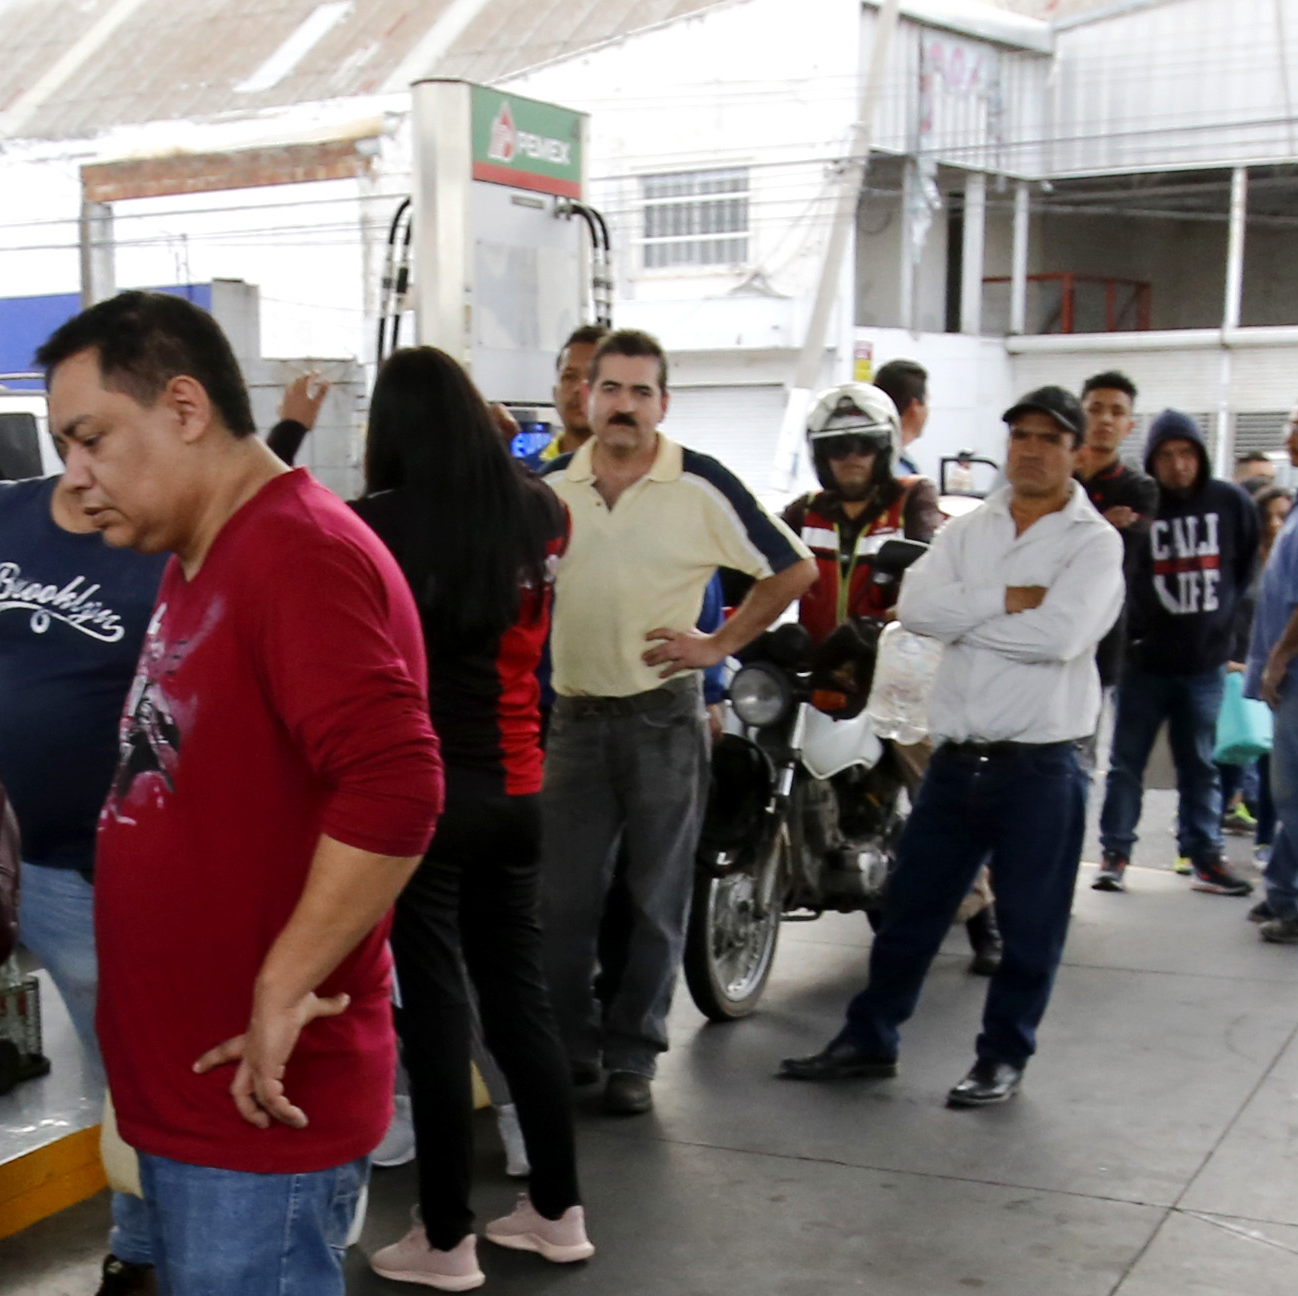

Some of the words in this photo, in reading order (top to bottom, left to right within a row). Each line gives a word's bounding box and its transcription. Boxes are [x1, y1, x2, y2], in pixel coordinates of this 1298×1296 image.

[517, 131, 570, 165] PEMEX
[1150, 513, 1220, 560] CALI
[1153, 568, 1220, 615] LIFE
